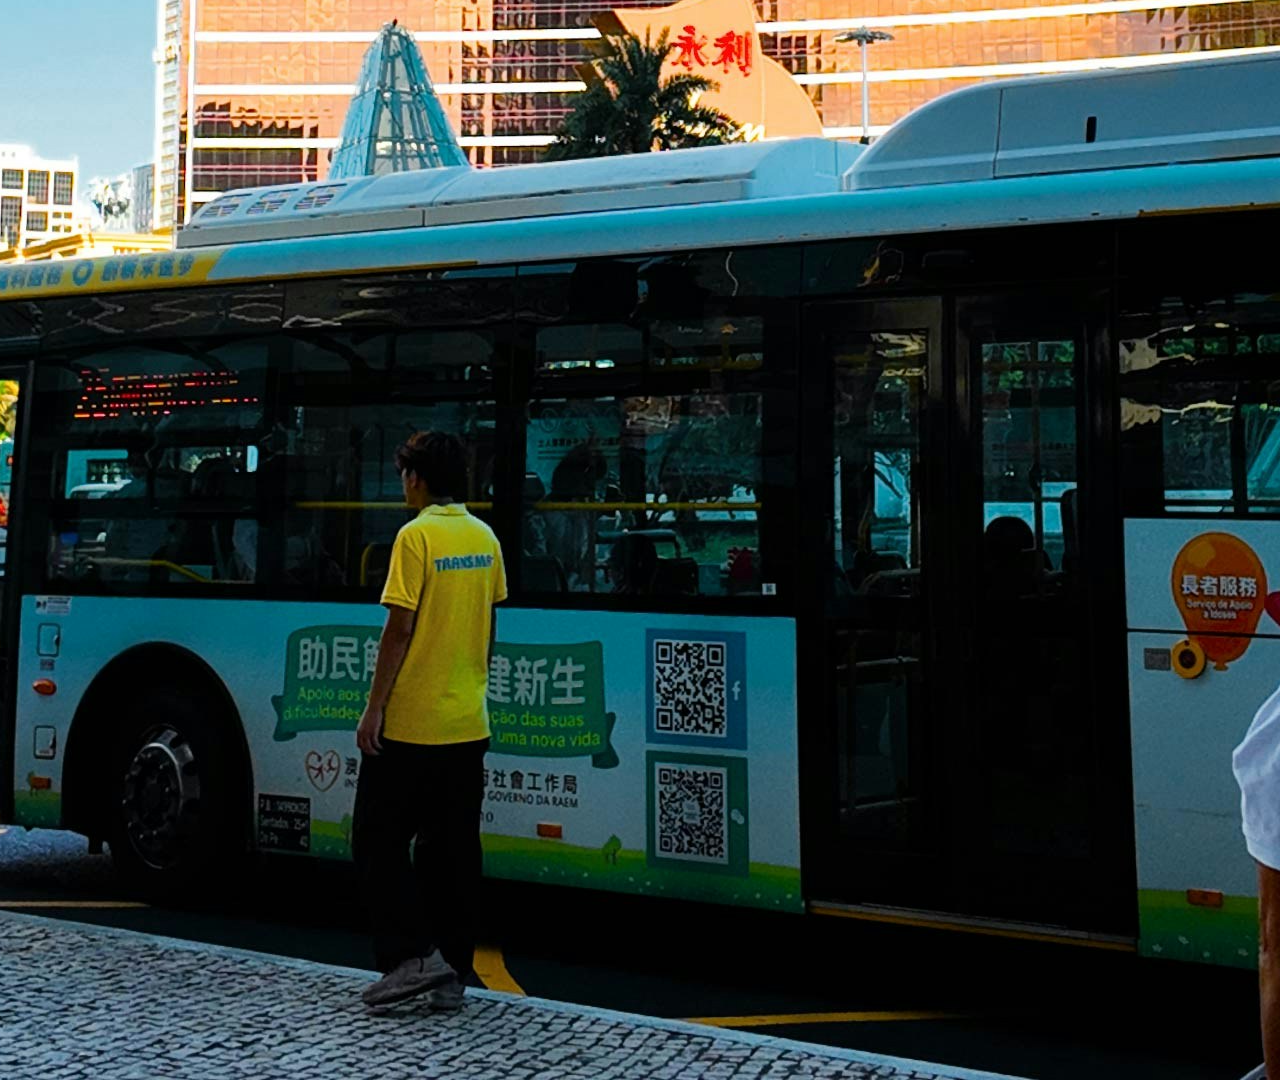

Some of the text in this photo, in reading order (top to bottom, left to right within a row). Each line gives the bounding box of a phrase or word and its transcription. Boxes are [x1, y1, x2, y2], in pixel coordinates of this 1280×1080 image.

[670, 25, 753, 78] 永利
[434, 554, 494, 573] TRANSMA
[1181, 574, 1257, 598] 長者服務
[297, 686, 335, 703] Apoio
[337, 689, 361, 702] aos
[521, 710, 546, 728] das
[549, 715, 585, 729] suas
[497, 731, 527, 746] uma
[530, 734, 566, 749] nova
[569, 731, 601, 747] vida
[487, 790, 578, 808] GOVERNO DA RAEM
